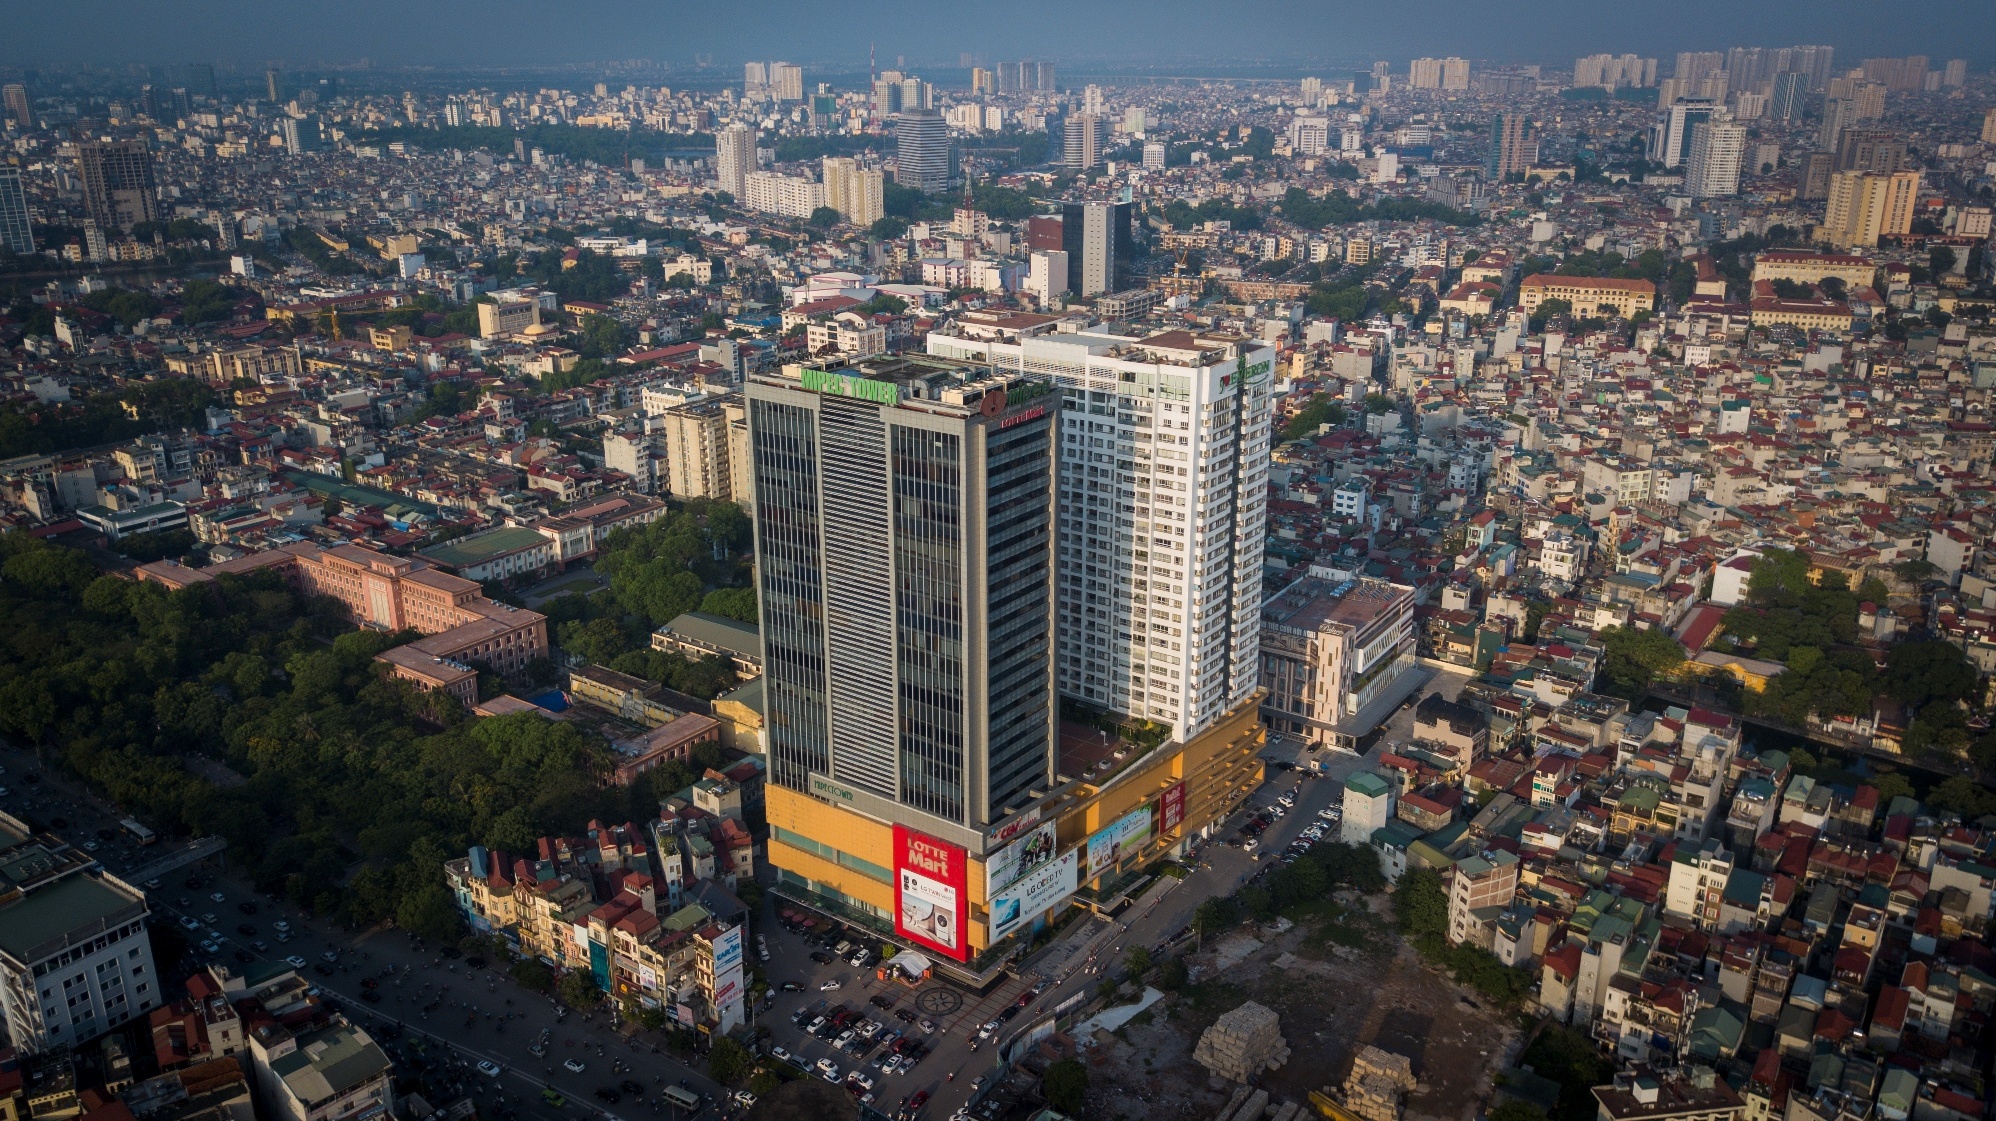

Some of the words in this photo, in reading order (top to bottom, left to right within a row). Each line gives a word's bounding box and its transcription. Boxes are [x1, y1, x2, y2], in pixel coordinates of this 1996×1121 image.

[801, 368, 844, 396] MIPEC
[849, 376, 897, 405] TOWER
[1007, 380, 1051, 406] mipec
[1001, 817, 1021, 840] CGV
[907, 838, 948, 861] LOTTE
[908, 849, 948, 878] Mart
[1026, 885, 1036, 897] LG
[1036, 873, 1054, 890] OLED
[1054, 868, 1063, 879] TV
